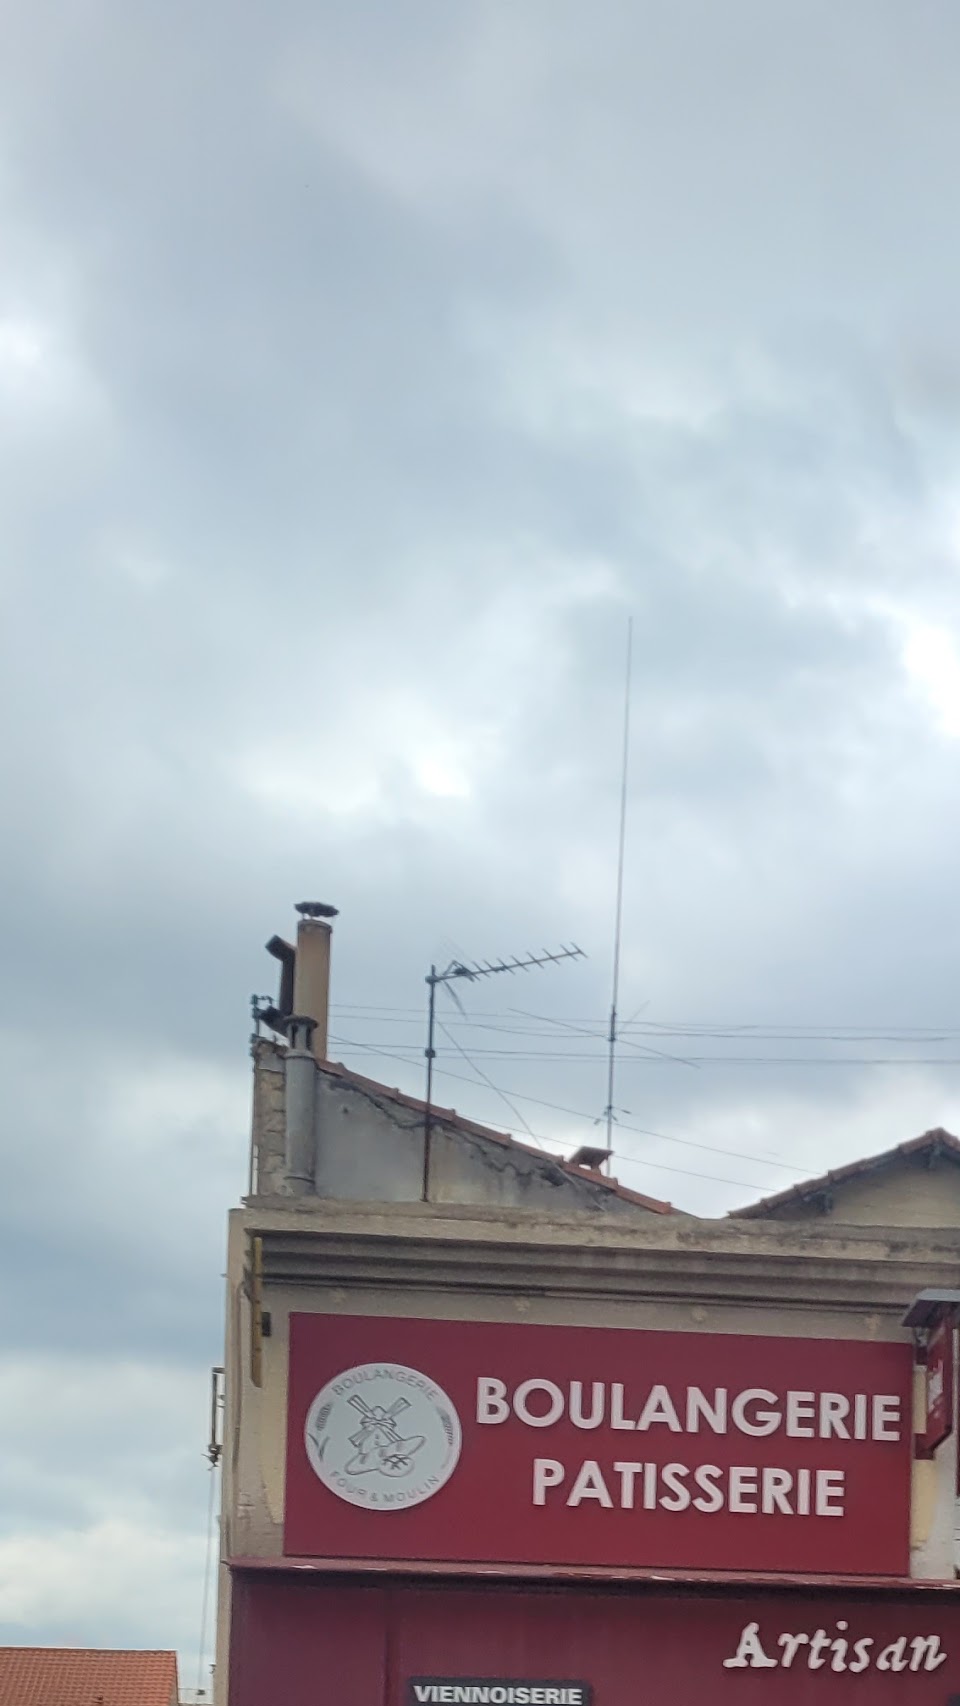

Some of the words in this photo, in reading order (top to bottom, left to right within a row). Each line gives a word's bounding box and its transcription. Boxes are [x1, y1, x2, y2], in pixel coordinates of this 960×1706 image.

[331, 1368, 440, 1400] BOULANGERIE
[476, 1376, 901, 1442] BOULANGERIE
[383, 1475, 440, 1502] MOULIN
[532, 1458, 846, 1517] PATISSERIE
[722, 1620, 948, 1673] Artisan
[413, 1685, 583, 1706] VIENNOISERIE
